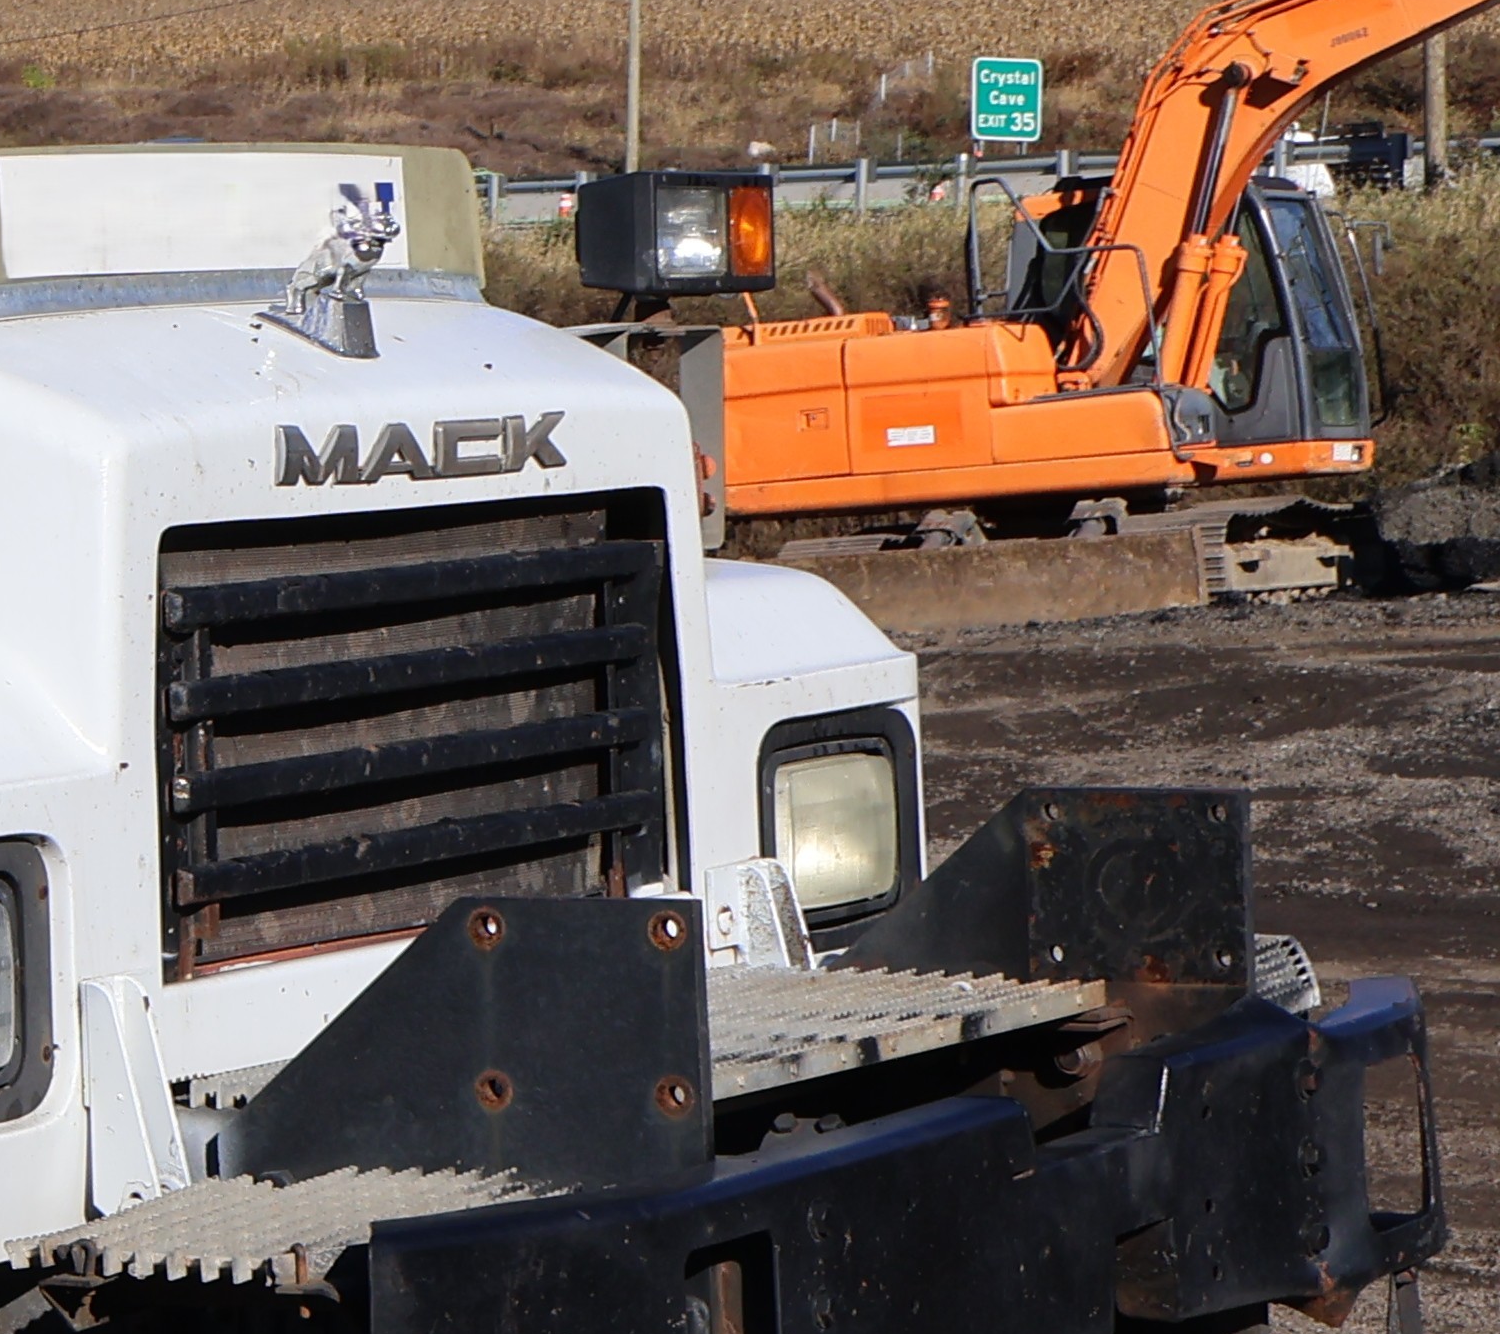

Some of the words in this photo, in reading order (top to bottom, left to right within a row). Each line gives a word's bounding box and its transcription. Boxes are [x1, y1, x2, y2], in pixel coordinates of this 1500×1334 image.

[980, 68, 1036, 87] Crystal
[989, 90, 1025, 106] Cave
[978, 114, 1007, 128] EXIT
[1010, 112, 1035, 132] 35
[274, 410, 567, 486] MACK
